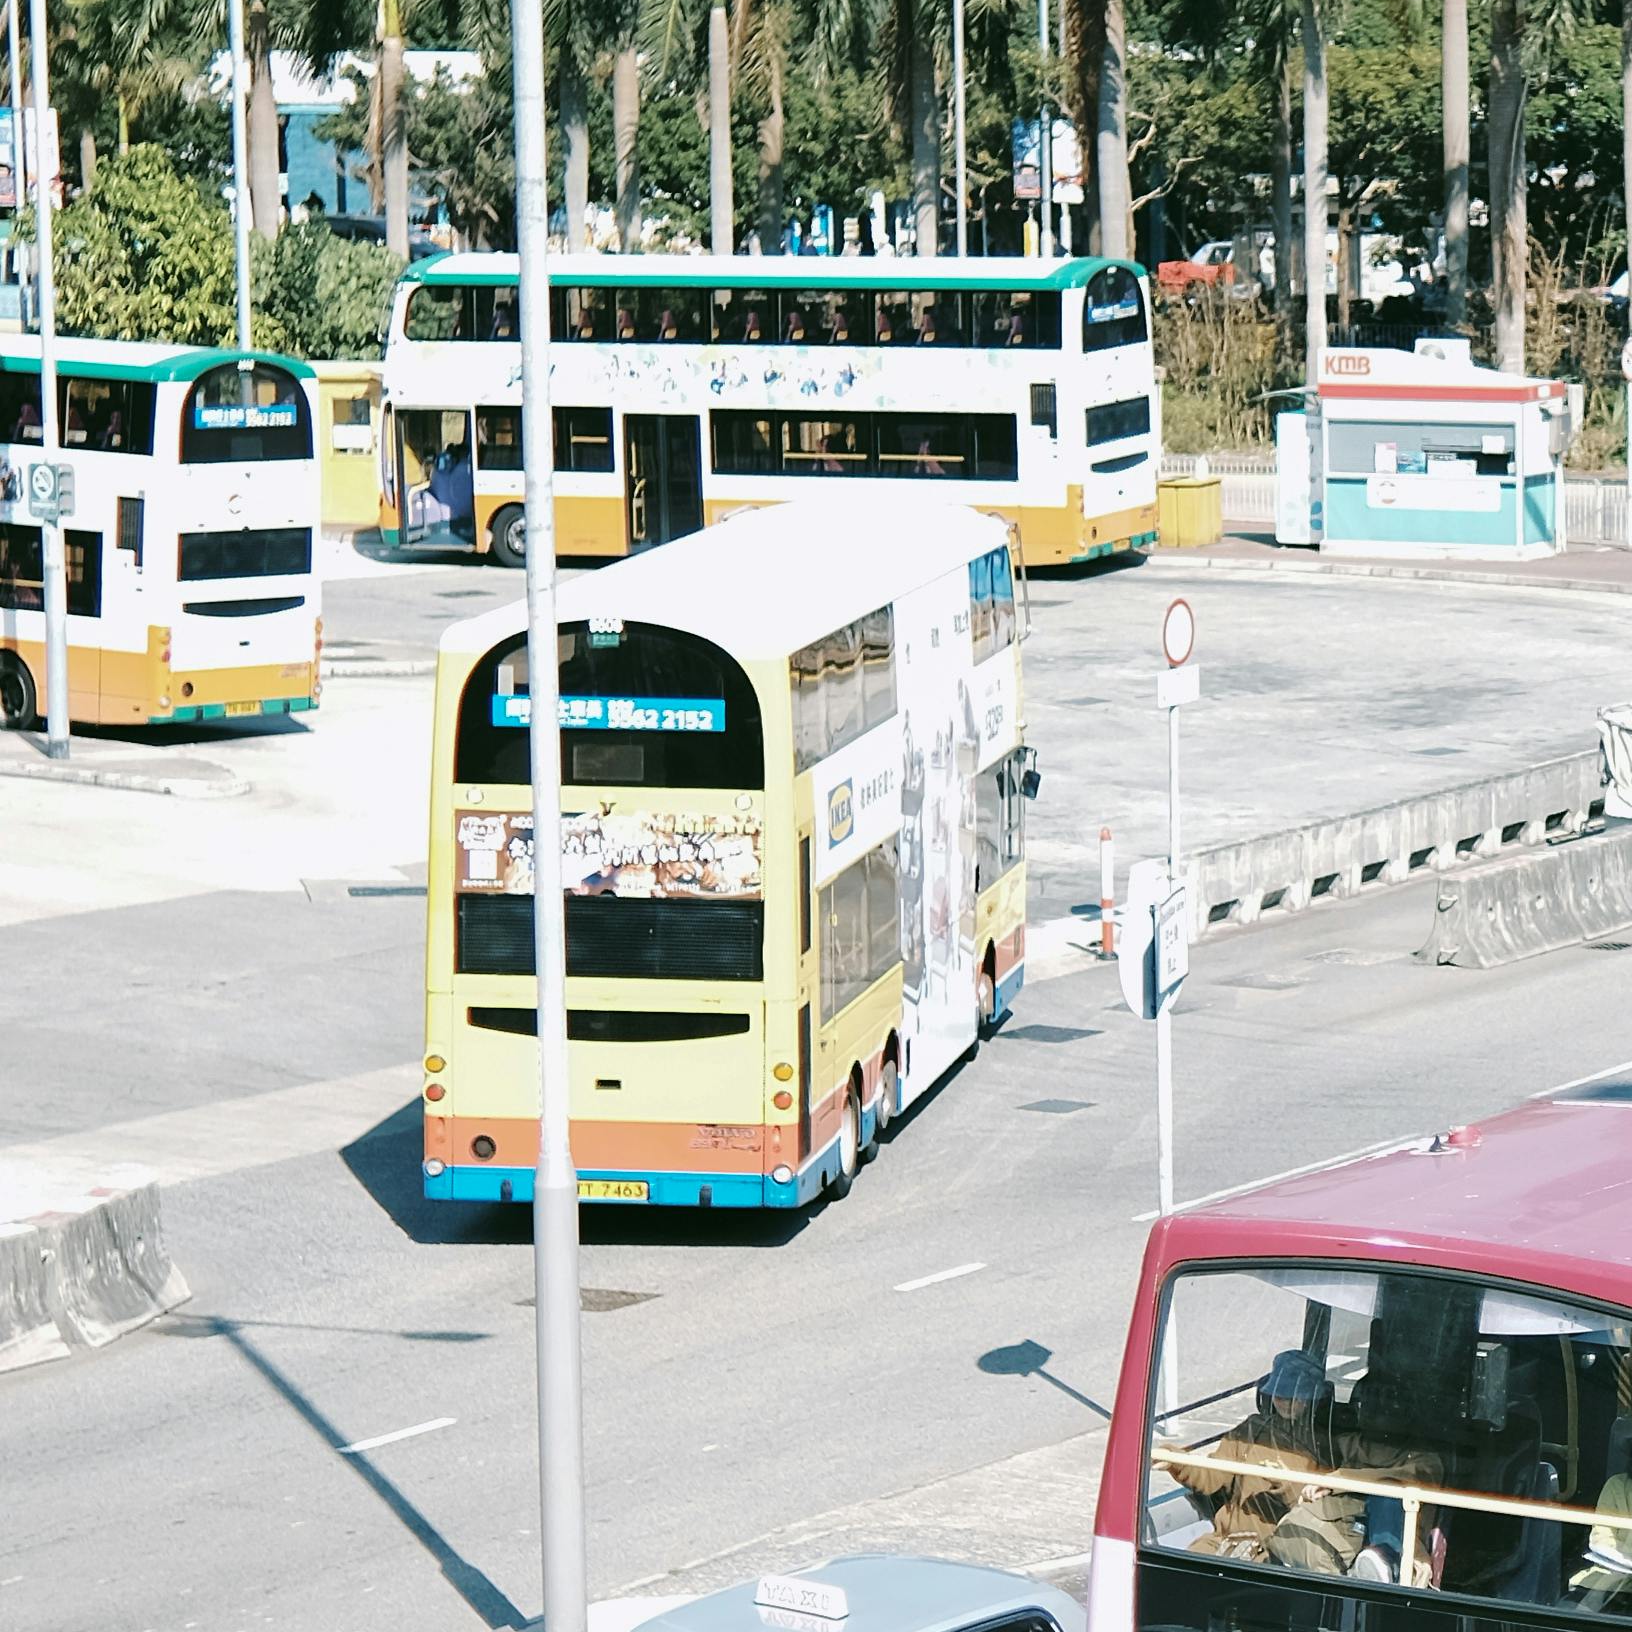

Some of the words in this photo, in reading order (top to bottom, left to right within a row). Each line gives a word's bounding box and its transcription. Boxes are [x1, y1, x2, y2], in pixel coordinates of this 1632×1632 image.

[1325, 355, 1371, 376] KMB
[831, 798, 854, 830] IKEA
[602, 1183, 644, 1198] 7463
[764, 1582, 830, 1610] TAXI
